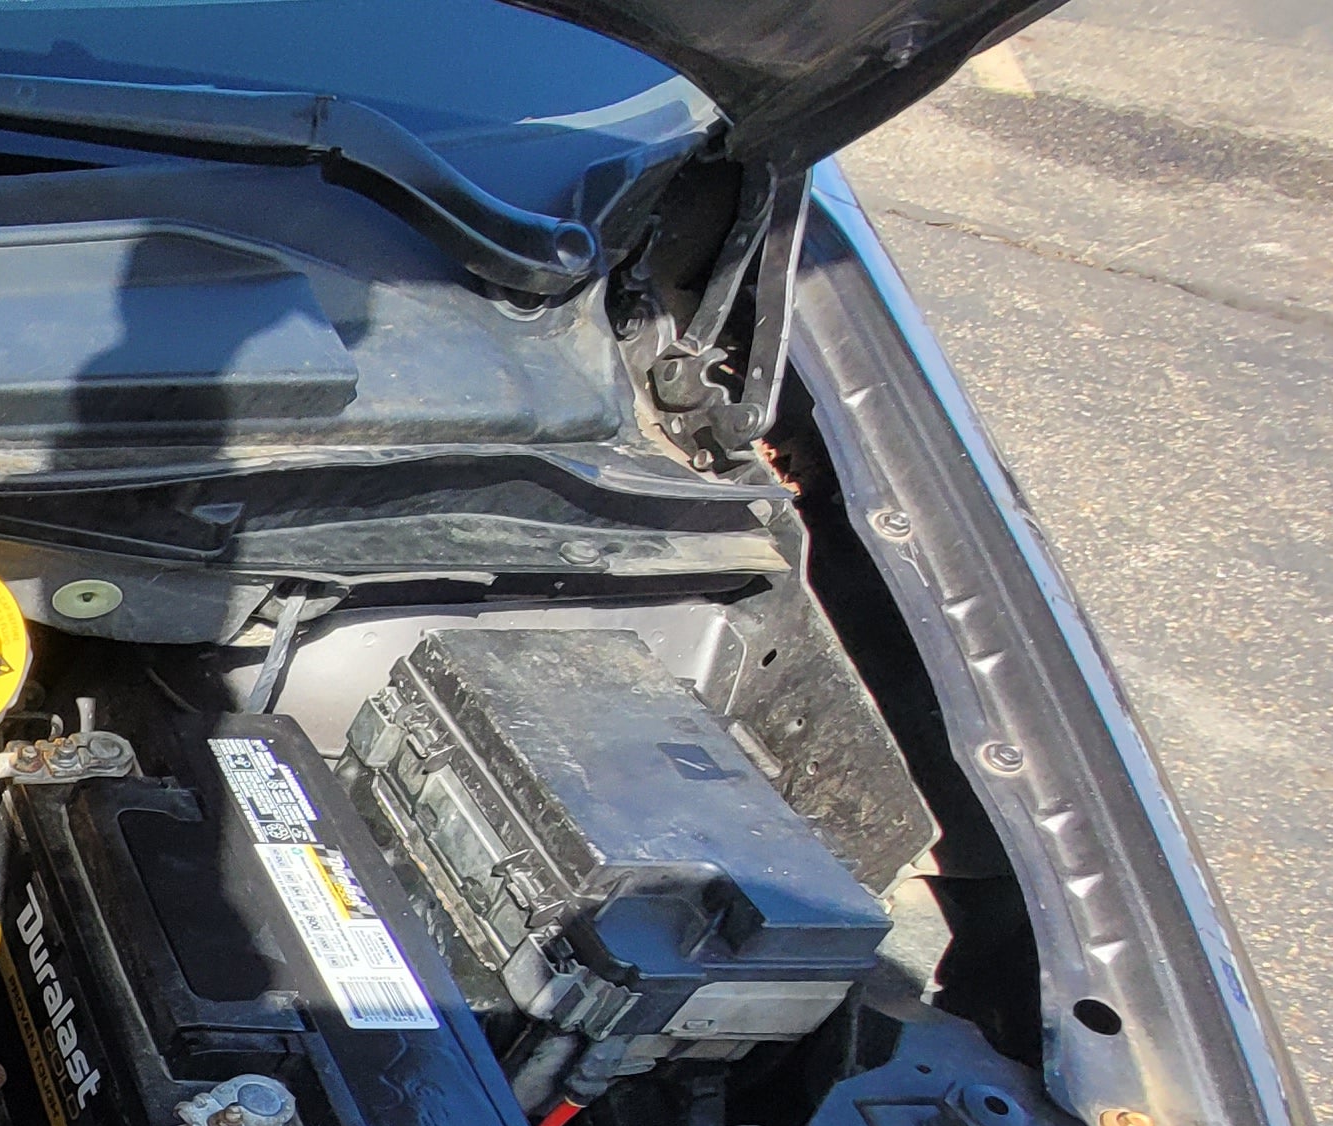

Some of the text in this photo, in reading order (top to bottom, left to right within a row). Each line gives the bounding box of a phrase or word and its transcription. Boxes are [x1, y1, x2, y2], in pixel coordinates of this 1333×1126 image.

[326, 855, 368, 908] Duralast
[17, 882, 101, 1112] Duralast
[41, 1025, 80, 1120] GOLD
